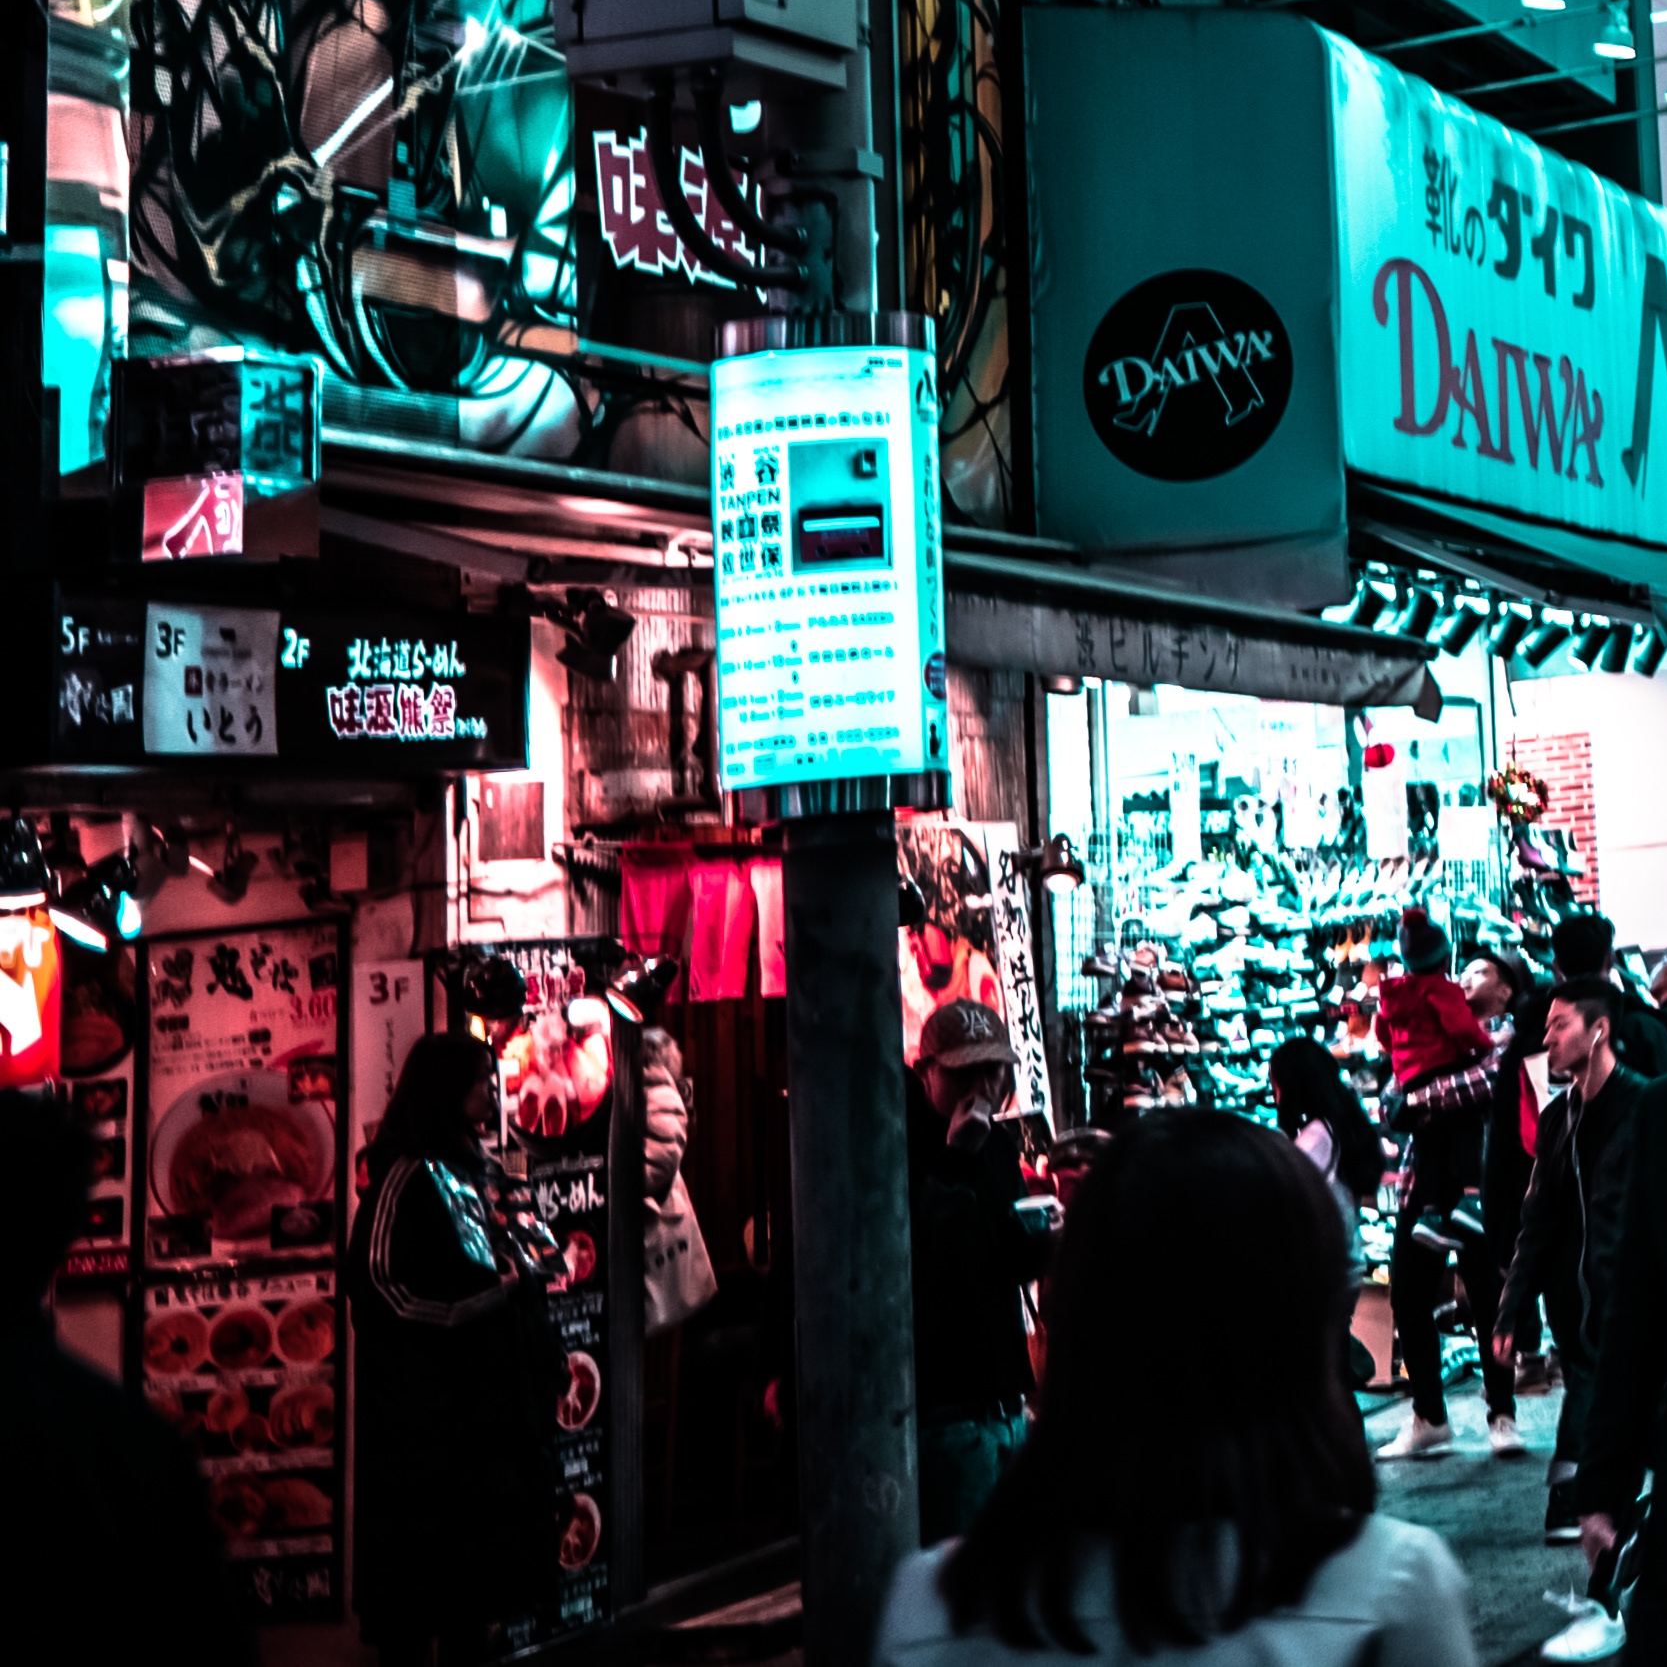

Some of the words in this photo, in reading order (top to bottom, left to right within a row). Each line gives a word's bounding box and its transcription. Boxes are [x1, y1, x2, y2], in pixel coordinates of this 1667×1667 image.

[1422, 145, 1595, 311] 靴のダイワ
[1099, 329, 1274, 404] DAIWA
[1371, 258, 1605, 490] DAIWA
[60, 614, 90, 658] 5F
[156, 620, 187, 659] 3F
[281, 626, 311, 670] 2F
[186, 704, 263, 746] いとう
[369, 971, 410, 1006] 3F
